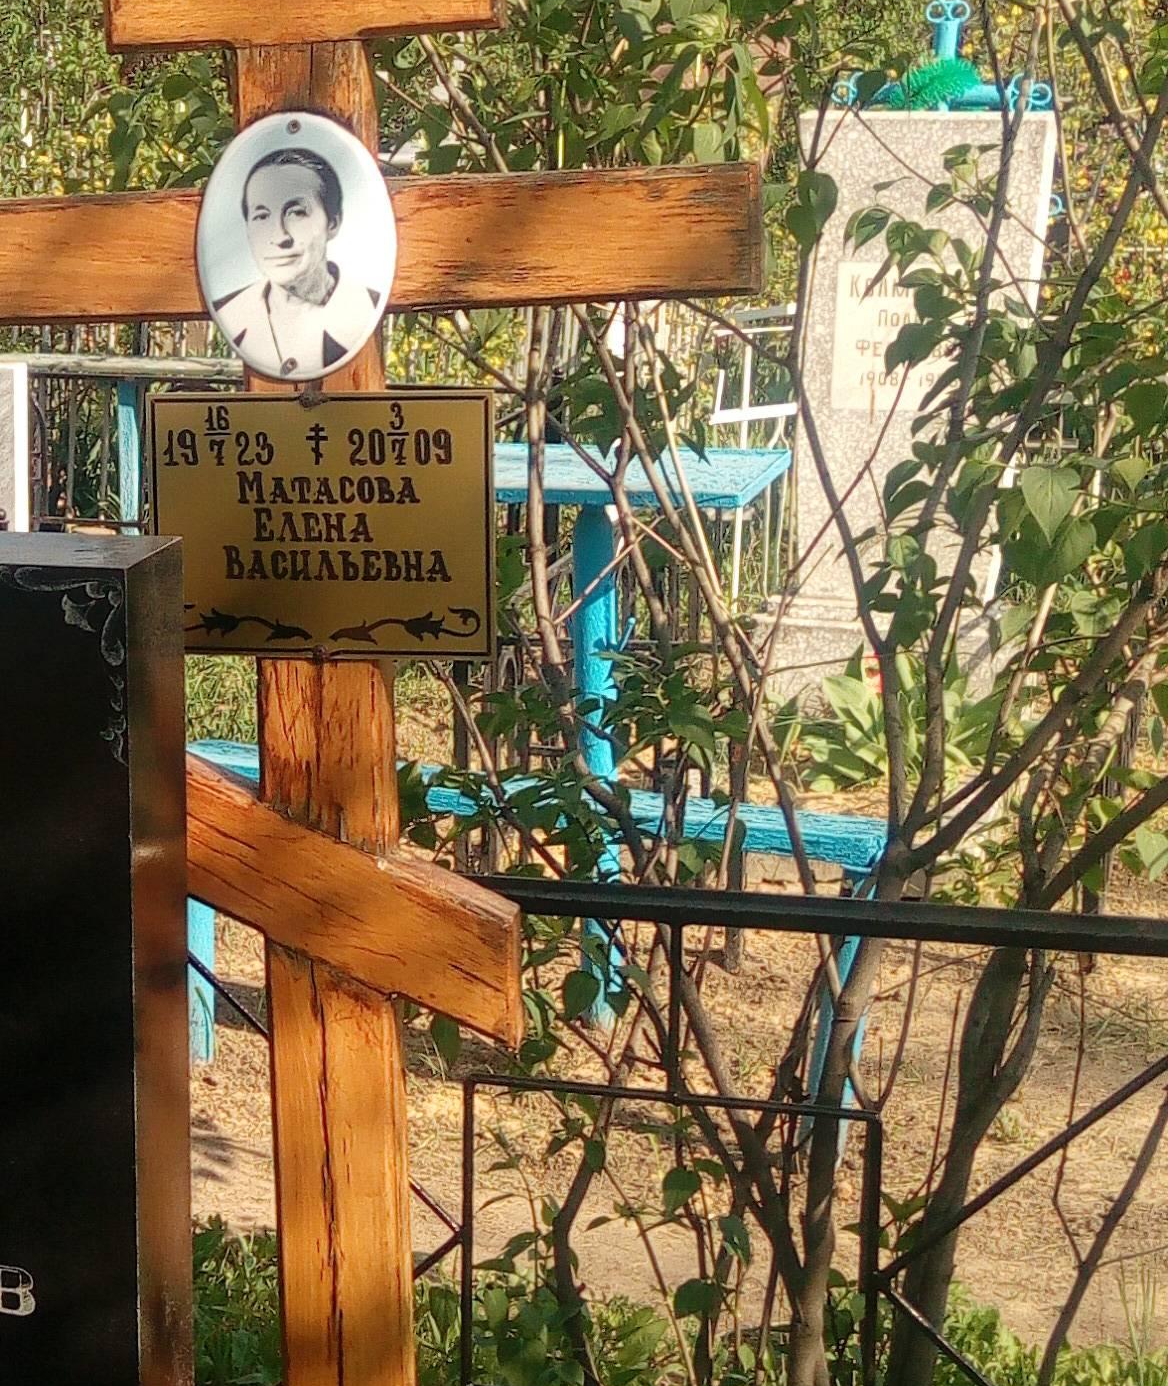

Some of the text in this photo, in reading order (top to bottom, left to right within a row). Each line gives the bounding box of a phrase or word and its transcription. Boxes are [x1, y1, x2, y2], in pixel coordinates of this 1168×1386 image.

[236, 470, 421, 505] МАТАСОВА
[252, 507, 374, 544] ЕЛЕНА
[222, 544, 452, 583] ВАСИЛЬЕВНА
